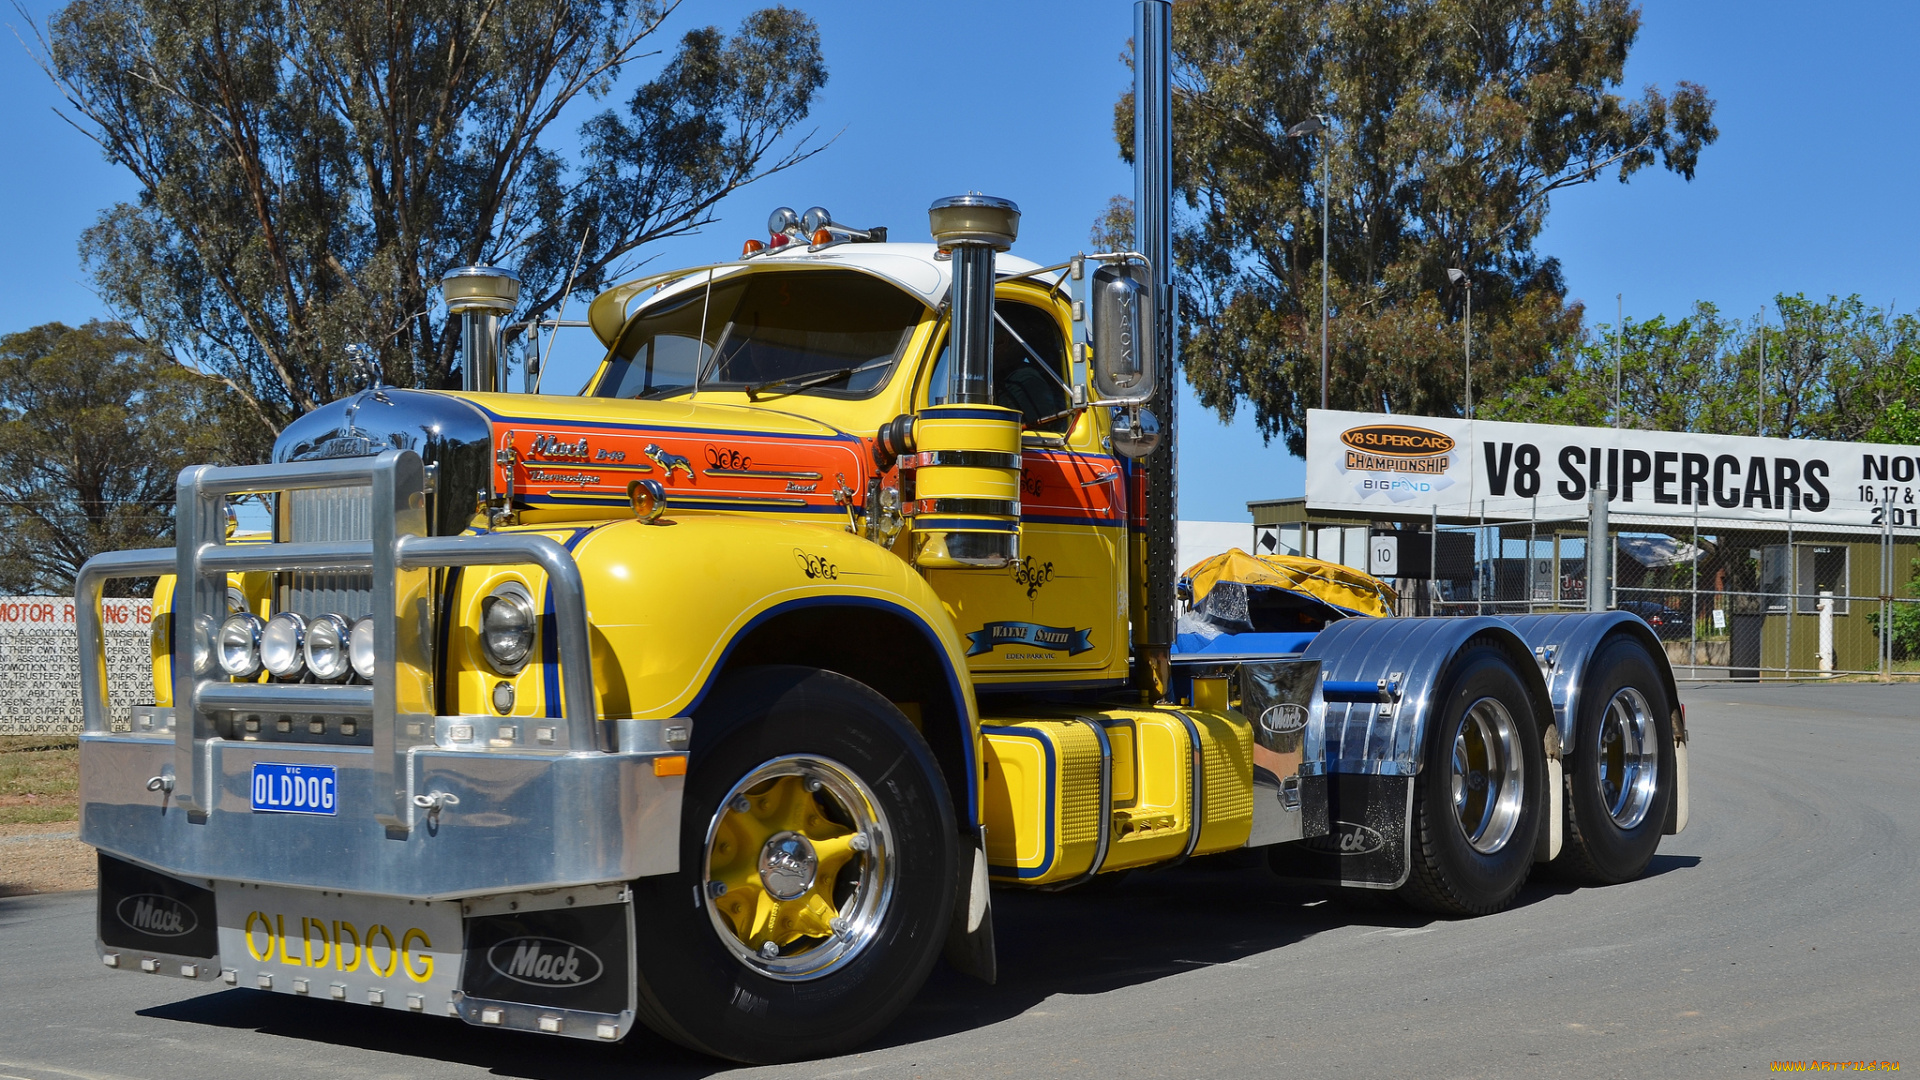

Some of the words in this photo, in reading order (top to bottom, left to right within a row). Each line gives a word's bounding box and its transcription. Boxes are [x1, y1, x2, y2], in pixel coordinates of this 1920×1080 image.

[527, 433, 589, 458] Mack
[1345, 433, 1364, 444] V8
[1365, 433, 1452, 450] SUPERCARS
[1346, 452, 1449, 473] CHAMPIONSHIP
[1862, 454, 1920, 483] NO
[1484, 441, 1541, 499] V8
[1557, 444, 1831, 513] SUPERCARS
[1858, 485, 1878, 506] 16,
[1882, 486, 1899, 503] 17
[1871, 506, 1919, 527] 201
[1377, 548, 1391, 562] 10
[0, 603, 54, 622] MOTOR
[136, 605, 152, 624] IS
[992, 625, 1028, 639] WAYNE
[1034, 629, 1069, 643] SMITH
[0, 664, 47, 672] ROMOTION
[1271, 706, 1303, 730] Mack
[255, 774, 334, 809] OLDDOG
[132, 896, 185, 933] Mack
[245, 909, 434, 985] OLDDOG
[508, 940, 582, 983] Mack
